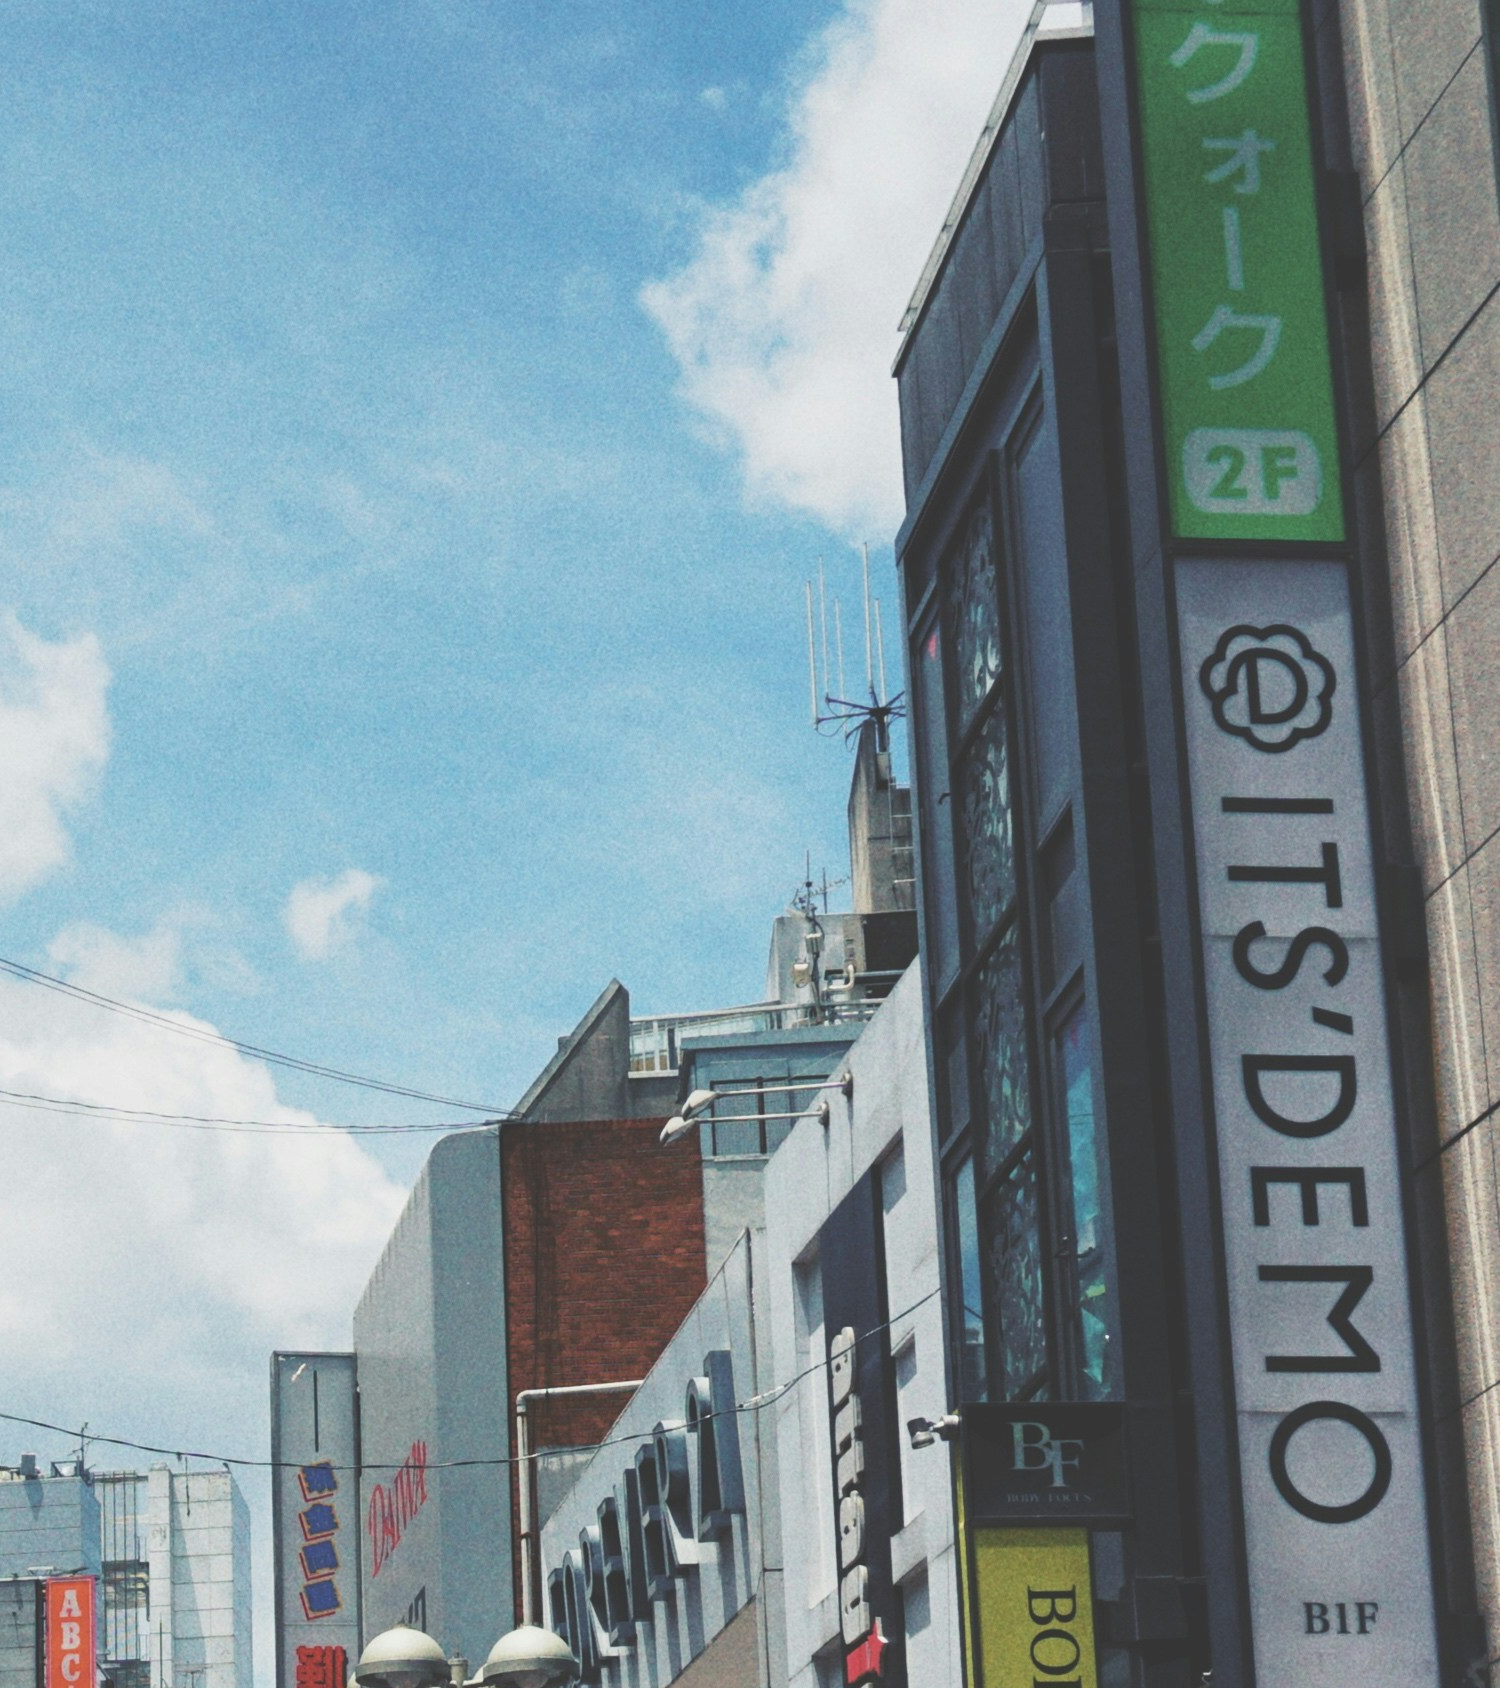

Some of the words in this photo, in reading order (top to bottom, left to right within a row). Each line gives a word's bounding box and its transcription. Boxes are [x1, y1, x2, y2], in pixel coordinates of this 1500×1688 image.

[1207, 445, 1298, 500] 2F
[1220, 797, 1396, 1524] ITS'DEMO
[1007, 1490, 1042, 1502] BODY
[1047, 1490, 1093, 1503] FOCUS
[1303, 1600, 1380, 1637] B1F
